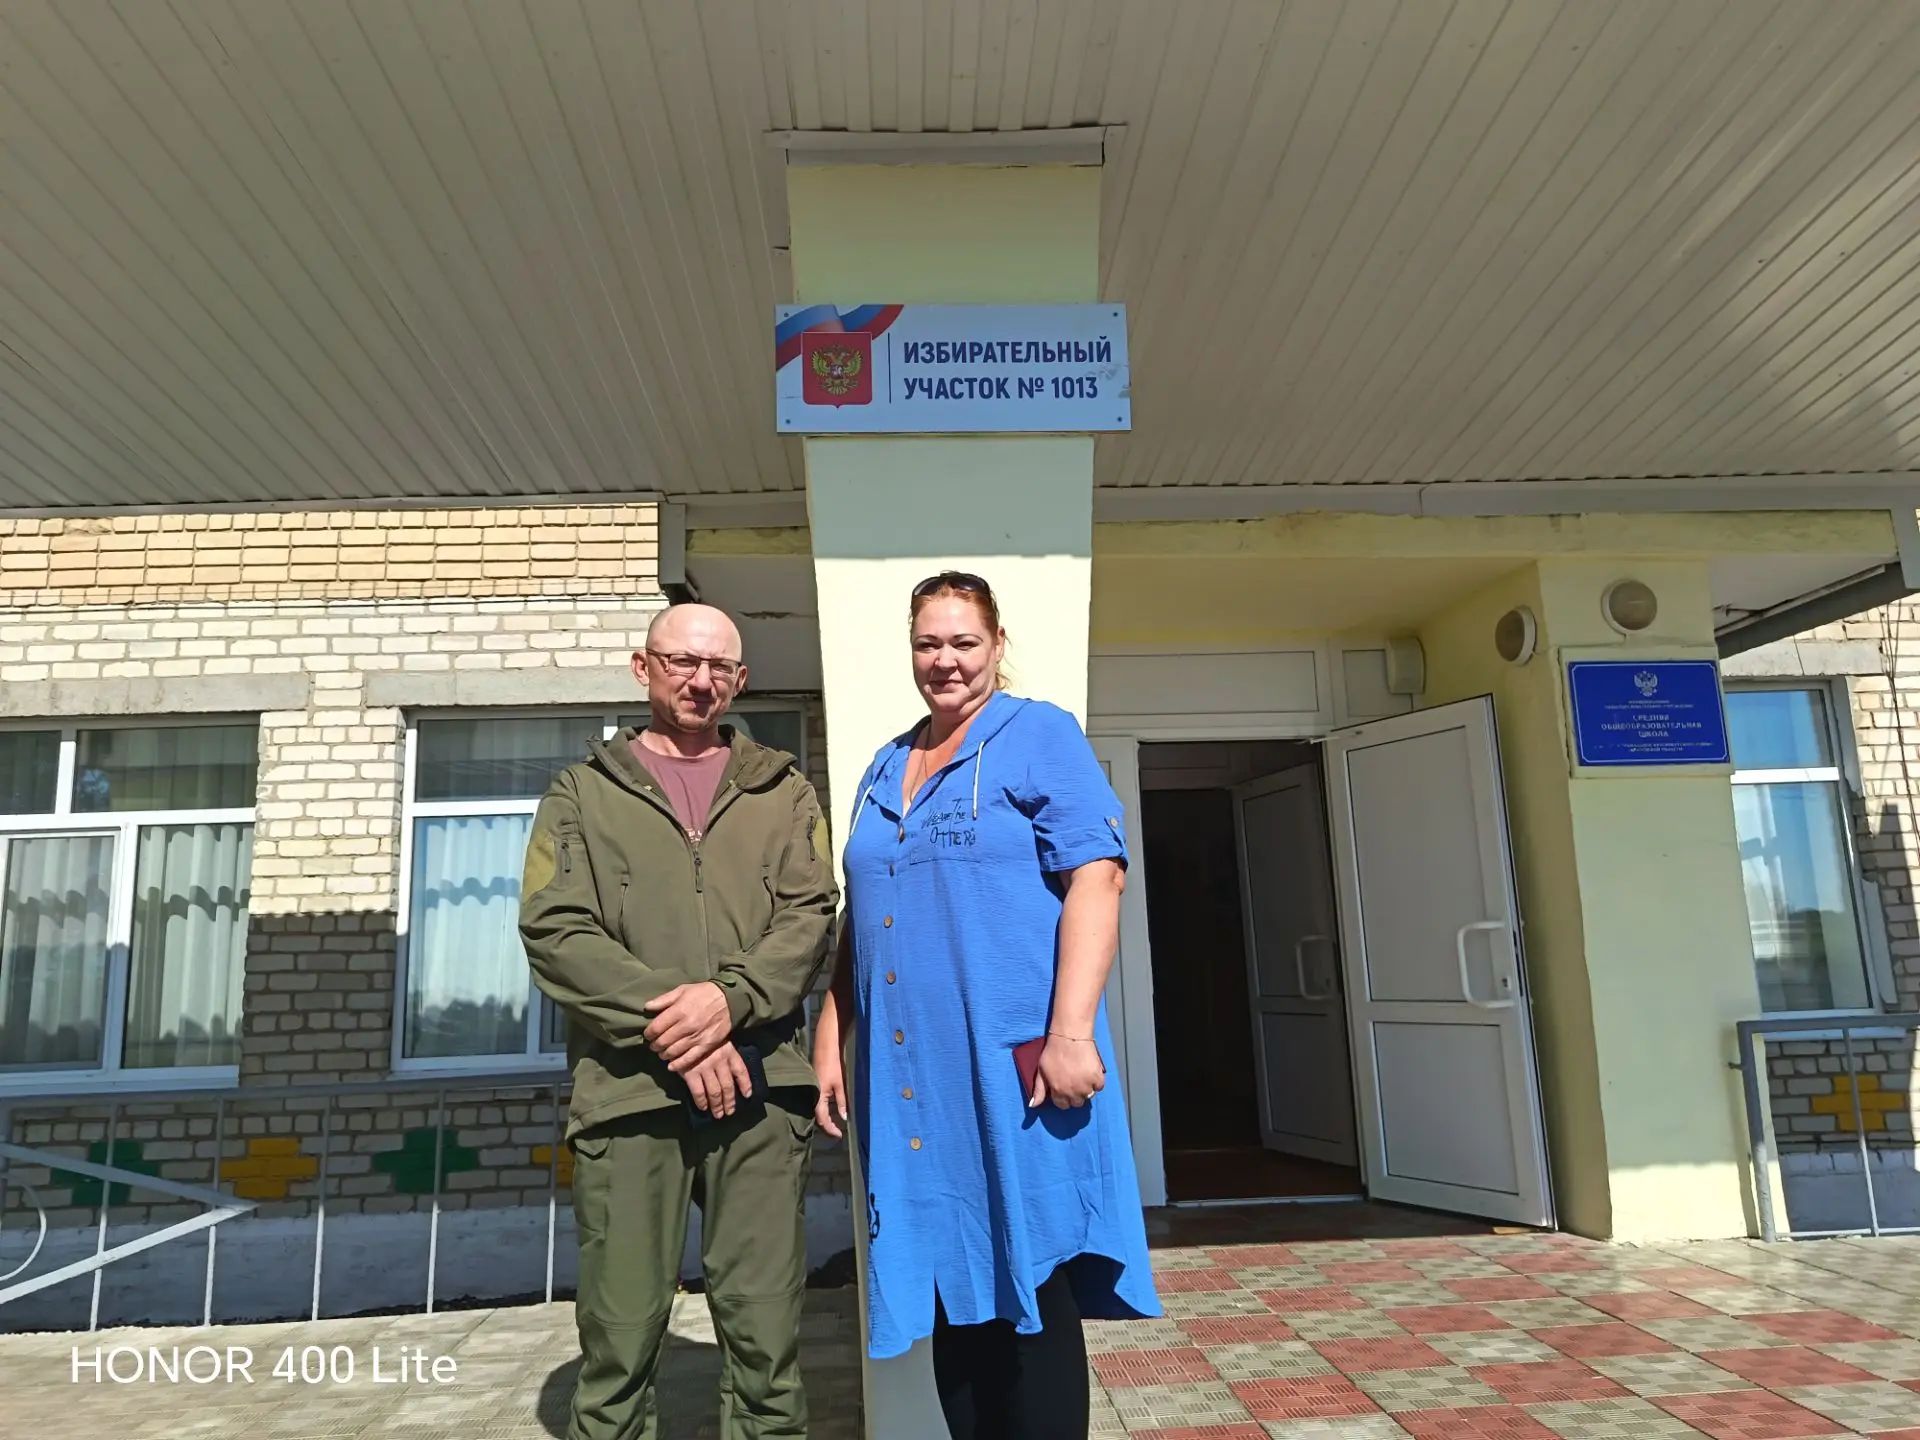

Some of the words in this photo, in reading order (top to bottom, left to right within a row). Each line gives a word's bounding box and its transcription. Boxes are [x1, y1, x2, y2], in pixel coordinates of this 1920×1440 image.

[903, 336, 1112, 364] ИЗБИРАТЕЛЬНЫЙ
[903, 376, 1011, 400] УЧАСТОК
[1018, 376, 1044, 399] №
[1051, 376, 1098, 399] 1013
[1638, 730, 1669, 738] ШКОЛА
